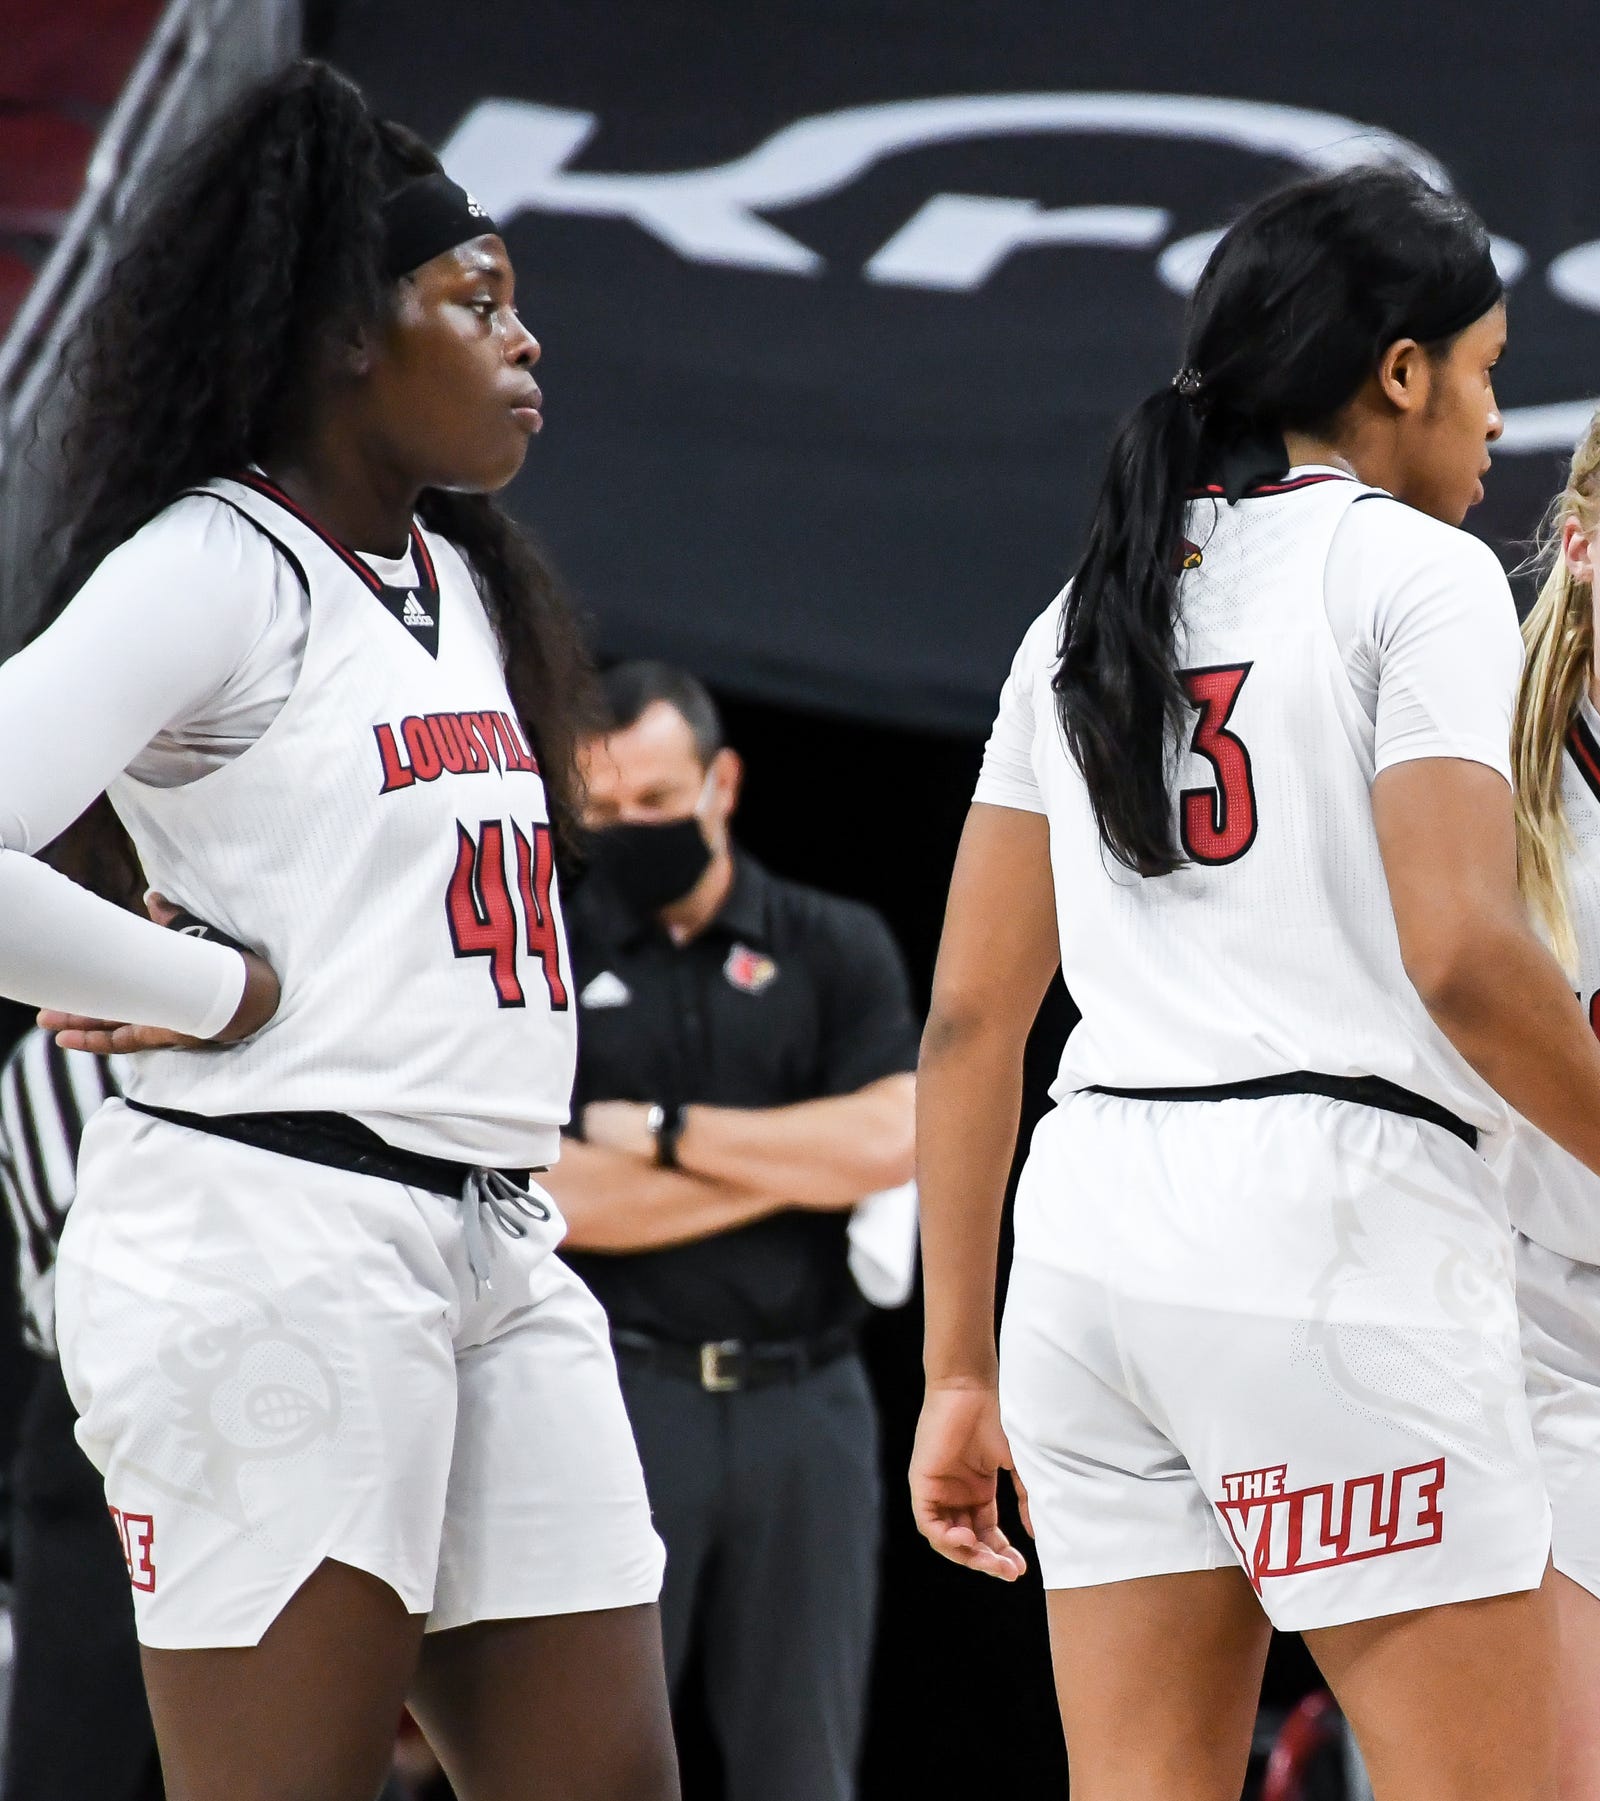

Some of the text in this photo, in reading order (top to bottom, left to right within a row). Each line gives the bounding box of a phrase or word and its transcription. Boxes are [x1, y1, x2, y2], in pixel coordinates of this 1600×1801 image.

[372, 710, 541, 795] LOUISVIL
[1174, 661, 1258, 867] 3
[444, 813, 568, 1012] 44
[1215, 1457, 1446, 1599] VILLE
[1222, 1464, 1287, 1501] THE
